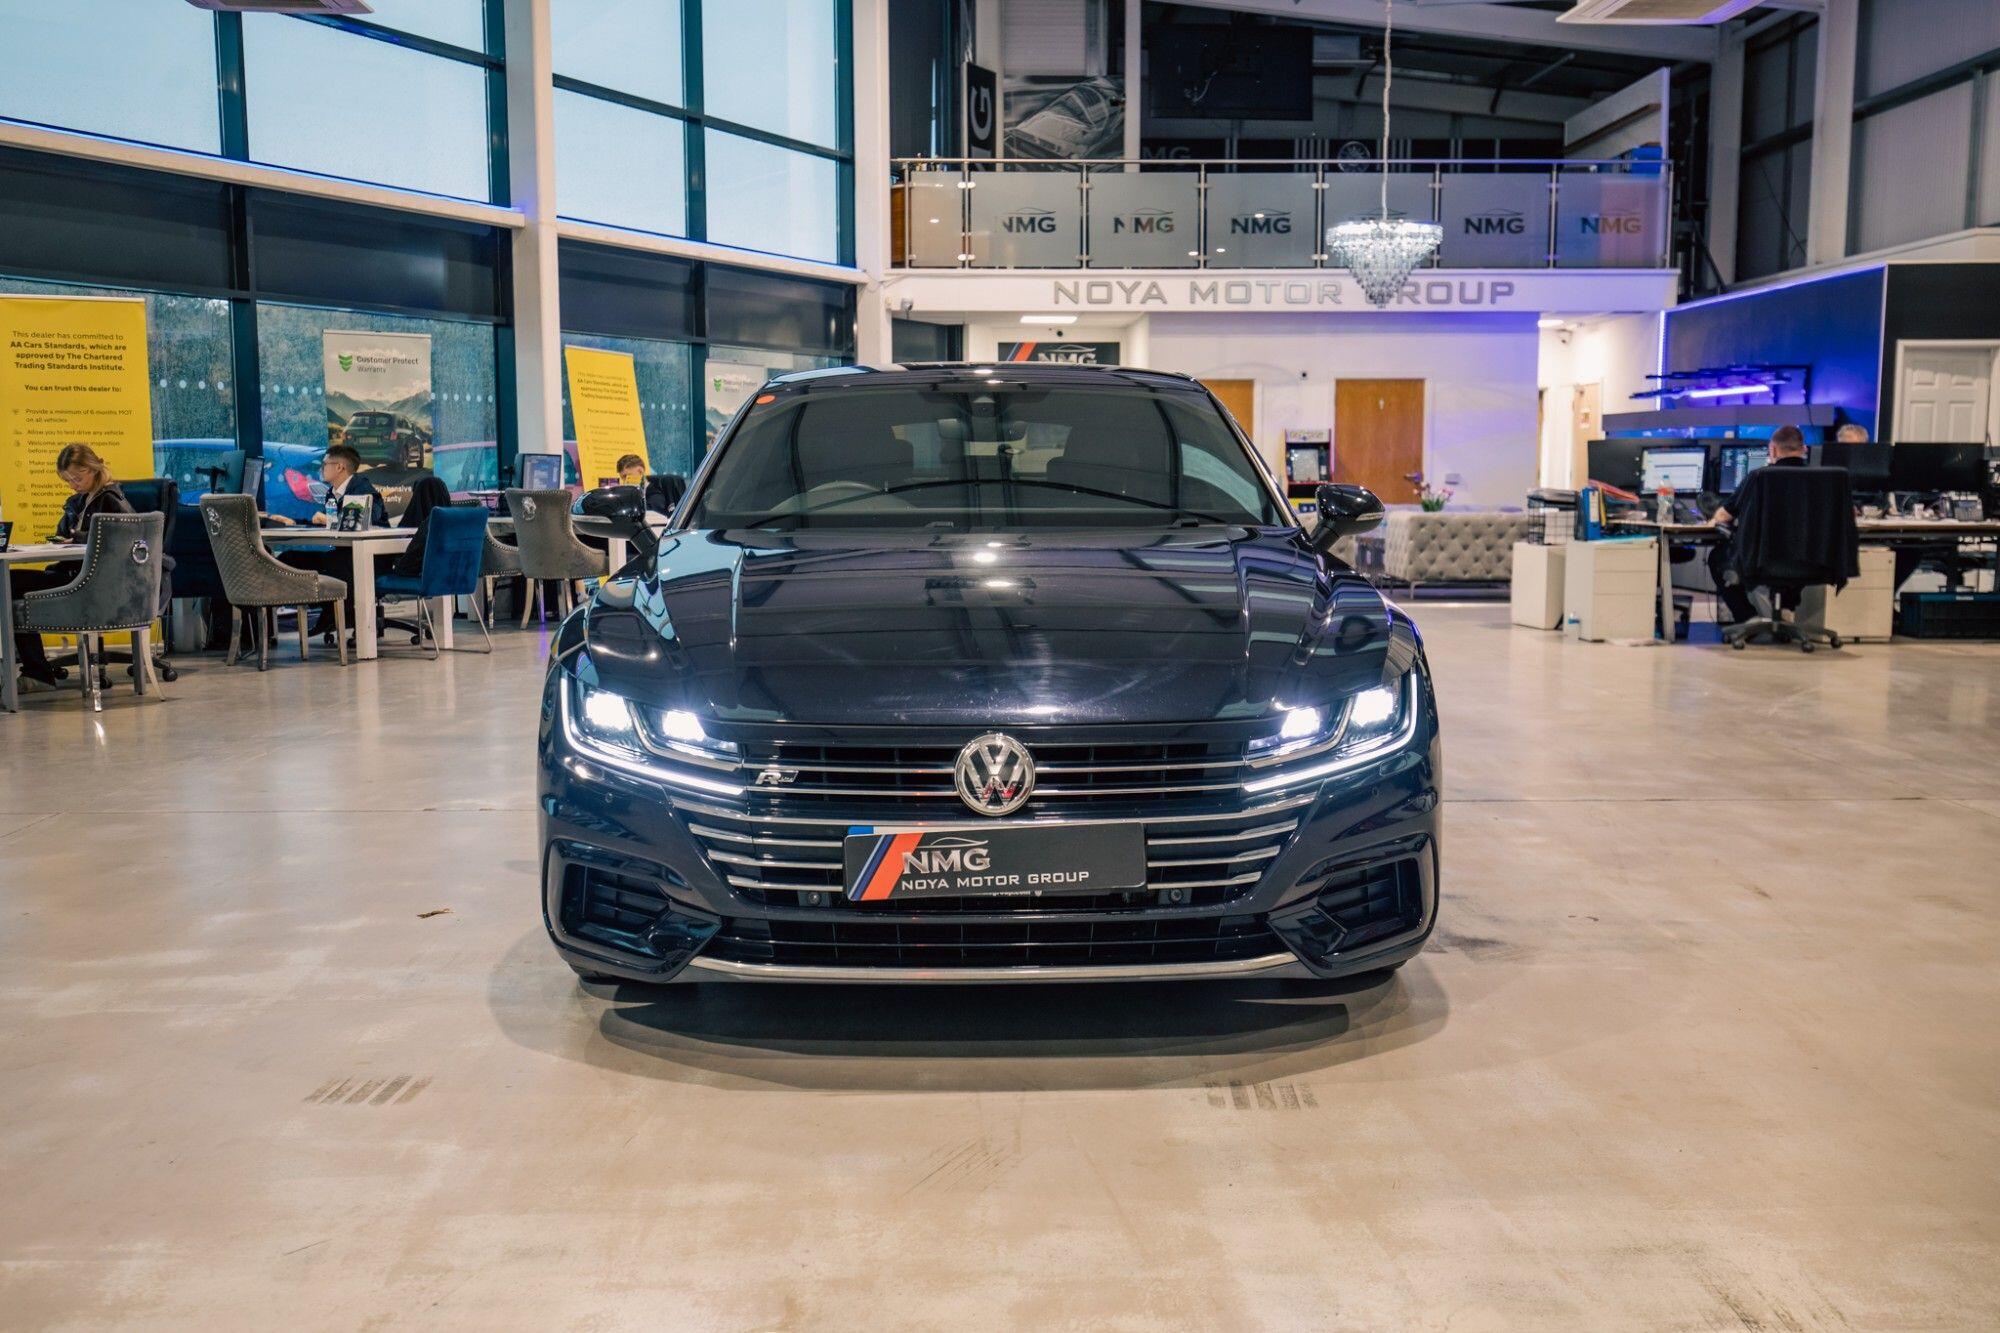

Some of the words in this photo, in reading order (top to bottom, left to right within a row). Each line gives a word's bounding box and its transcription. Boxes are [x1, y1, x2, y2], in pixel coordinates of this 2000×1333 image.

[1231, 217, 1292, 234] NMG
[1464, 218, 1525, 234] NMG
[1581, 217, 1642, 234] NMG
[1054, 281, 1168, 305] NOYA
[1189, 281, 1342, 305] MOTOR
[1364, 281, 1514, 305] ROUP
[31, 331, 55, 339] dealer
[44, 342, 88, 350] Standards,
[16, 352, 54, 360] approved
[83, 353, 123, 361] Chartered
[356, 356, 391, 364] Customer
[392, 357, 418, 365] Protect
[1038, 353, 1098, 364] NMG
[14, 362, 45, 370] Trading
[47, 362, 88, 370] Standards
[89, 363, 125, 371] Institute.
[902, 848, 991, 875] NMG
[901, 879, 949, 891] NOYA
[957, 875, 1020, 888] MOTOR
[1028, 871, 1090, 884] GROUP
